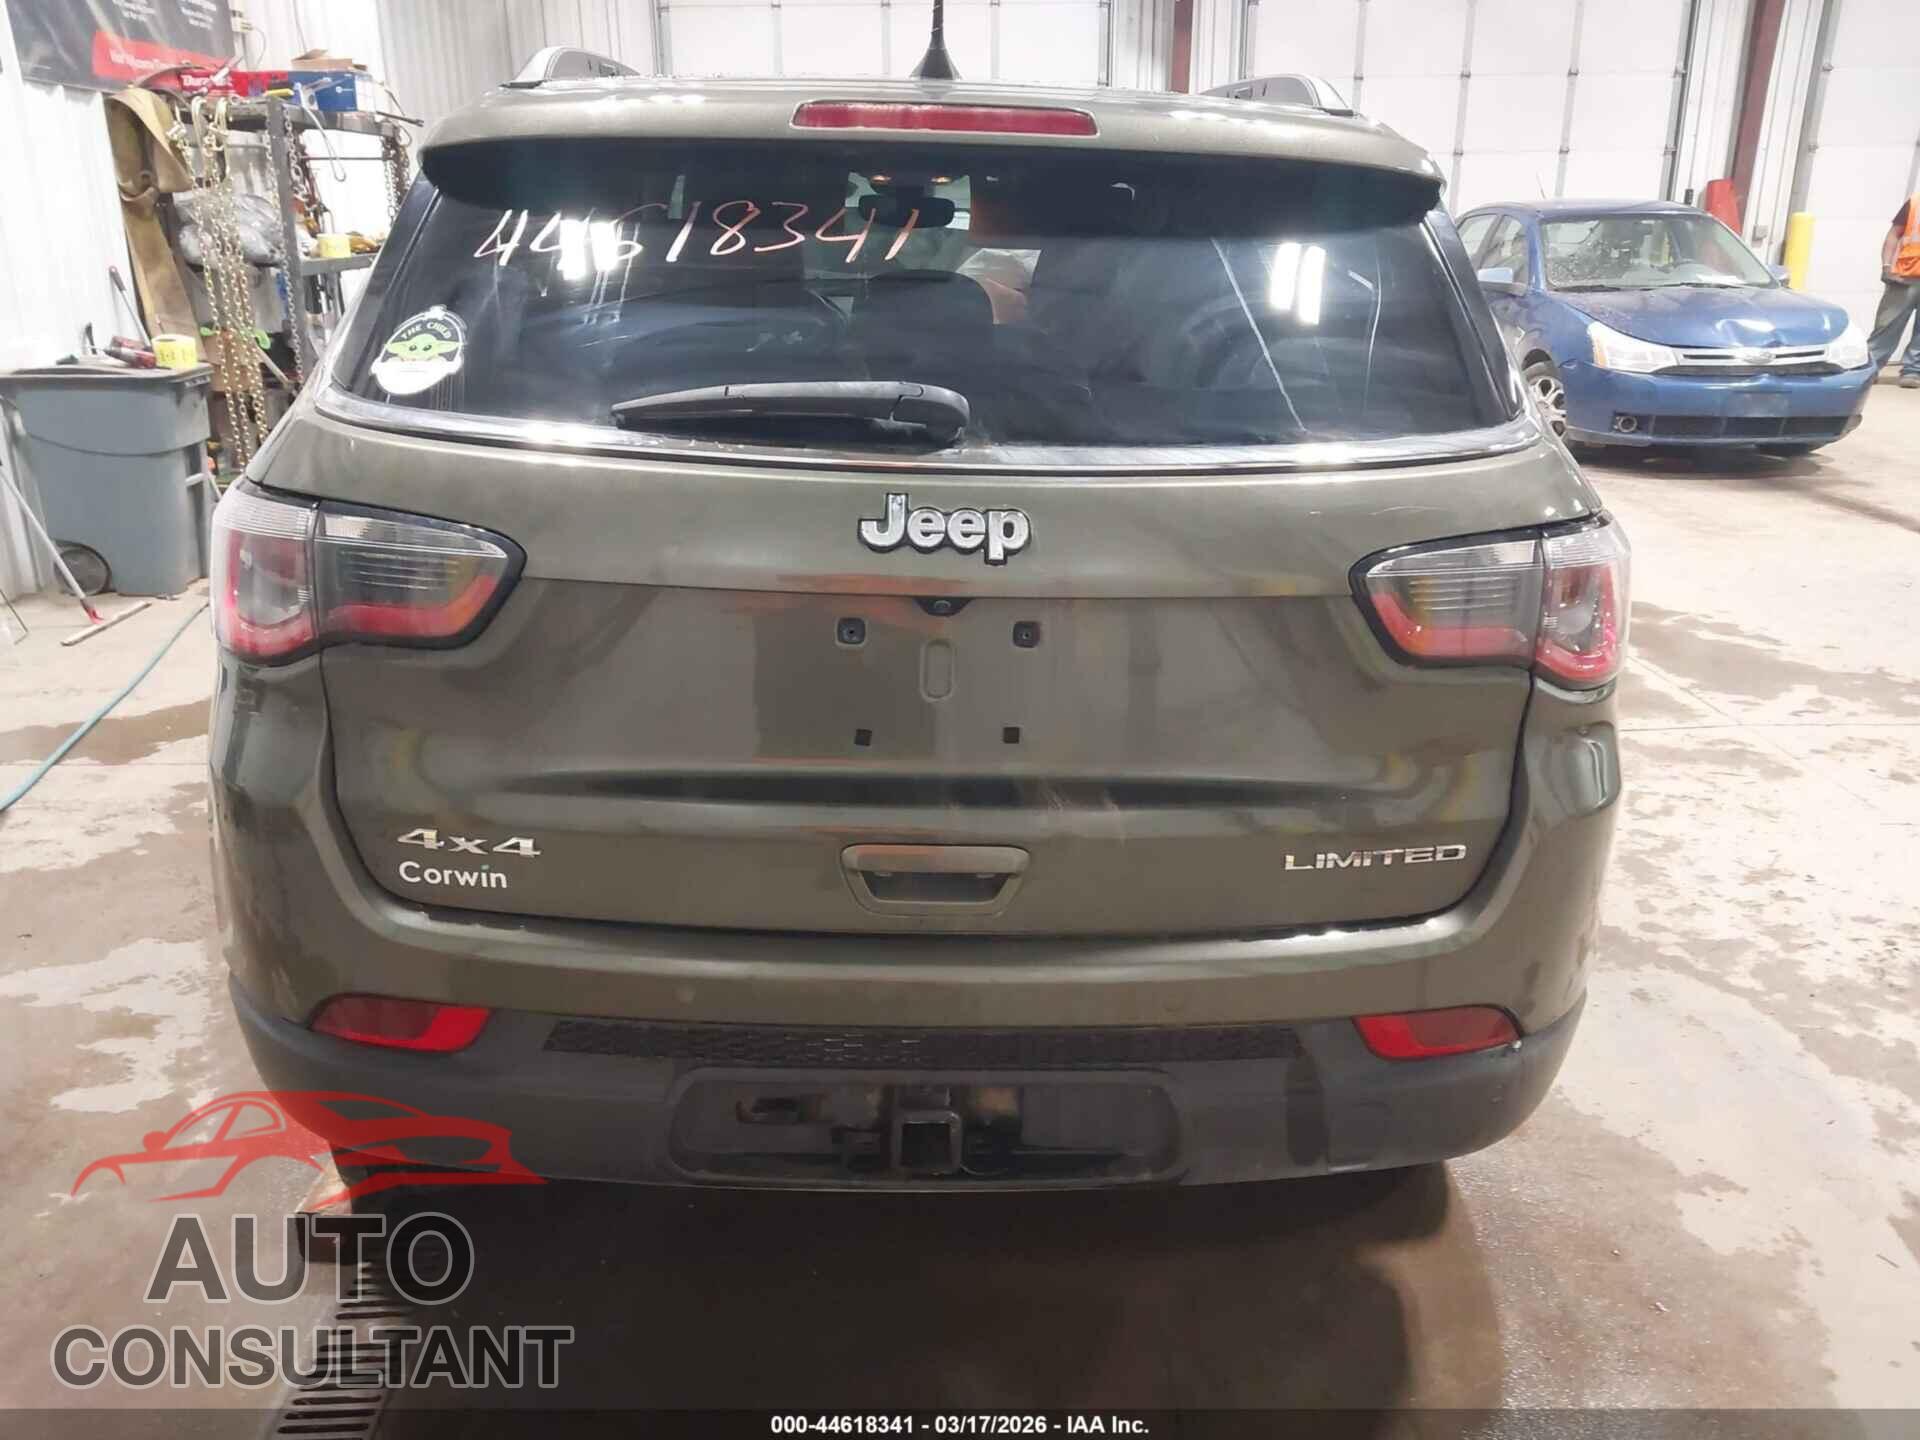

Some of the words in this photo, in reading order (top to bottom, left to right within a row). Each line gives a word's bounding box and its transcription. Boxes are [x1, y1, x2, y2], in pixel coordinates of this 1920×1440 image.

[473, 200, 920, 267] 44618341
[401, 323, 423, 340] THE
[858, 493, 1032, 566] Jeep
[397, 828, 542, 858] 4x4
[1284, 844, 1467, 871] LIMITED
[398, 860, 509, 889] Corwin
